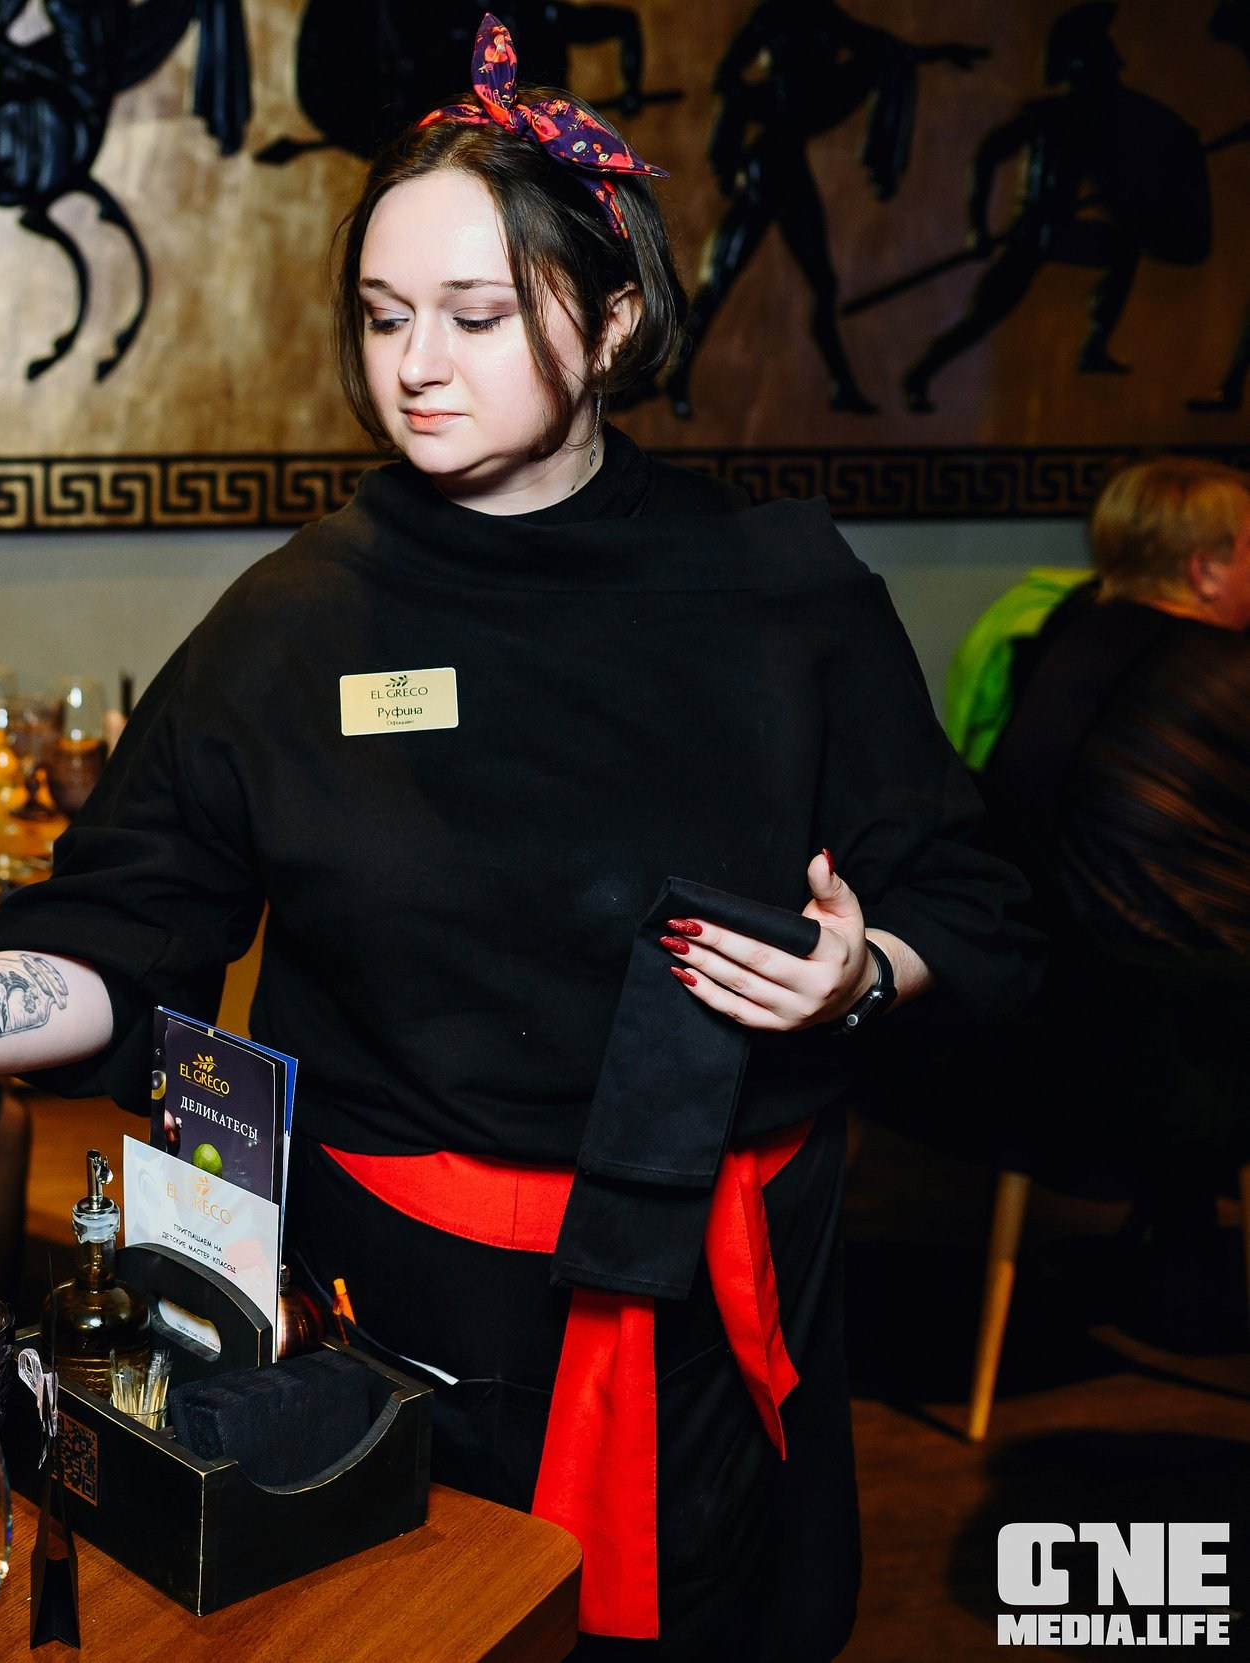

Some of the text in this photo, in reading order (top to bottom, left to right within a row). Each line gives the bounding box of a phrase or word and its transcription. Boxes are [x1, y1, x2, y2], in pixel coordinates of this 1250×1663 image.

[371, 687, 428, 699] EL GRECO
[377, 706, 423, 719] Руфина
[180, 1063, 191, 1079] EL
[193, 1070, 230, 1095] GRECO
[180, 1095, 258, 1141] ДЕЛИКАТЕСЫ
[166, 1183, 231, 1225] EL RECO
[162, 1231, 186, 1248] ДЕТСКИЕ
[173, 1223, 222, 1253] ПРИГЛАШАЕМ НА
